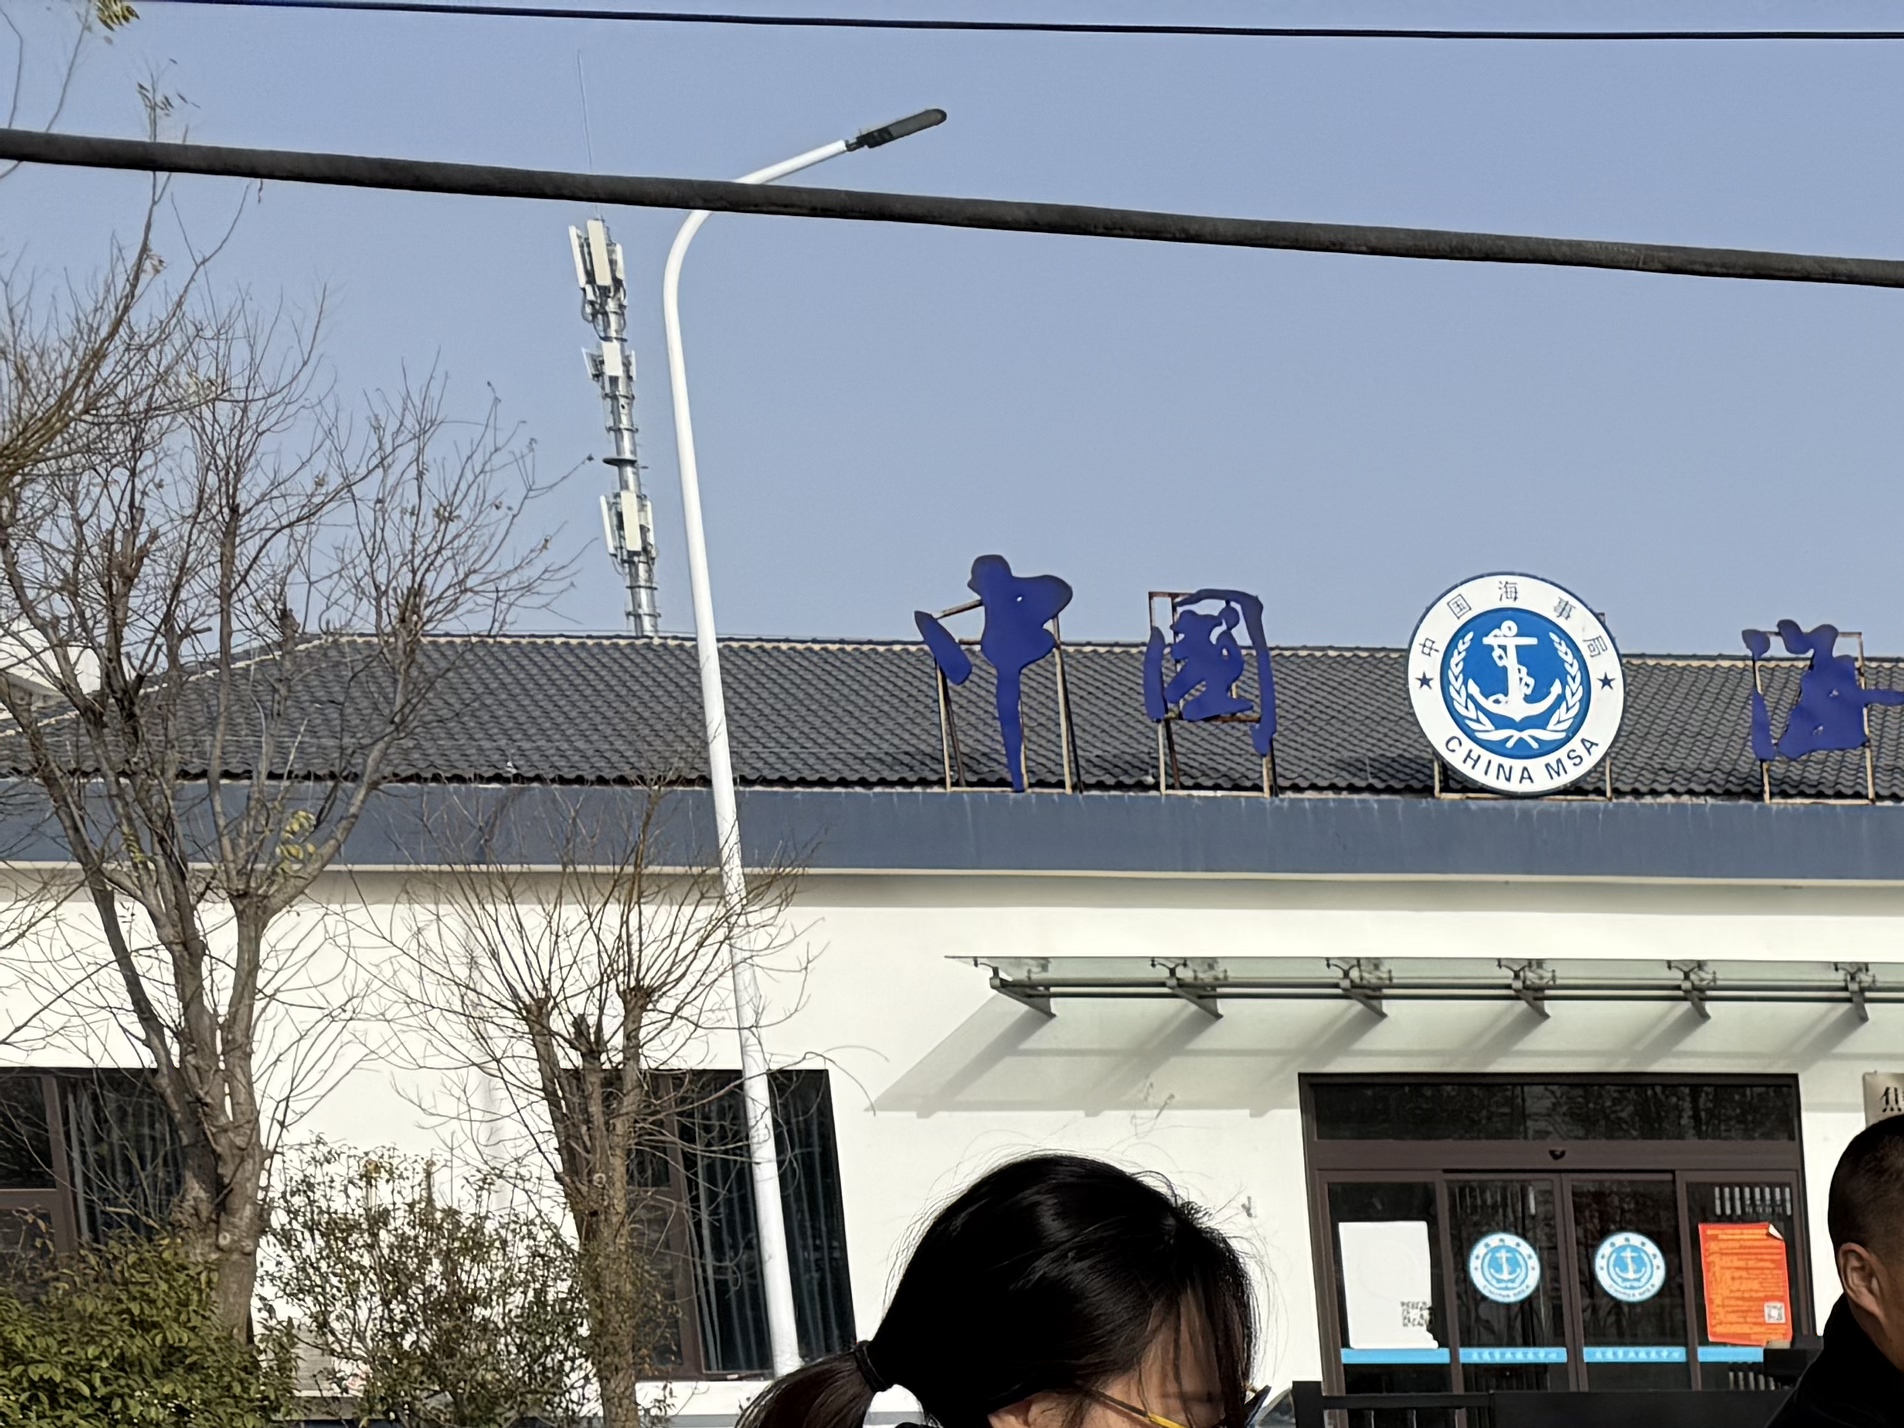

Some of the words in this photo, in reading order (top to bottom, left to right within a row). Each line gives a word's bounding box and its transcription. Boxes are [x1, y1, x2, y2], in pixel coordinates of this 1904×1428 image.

[1418, 580, 1608, 658] 中国海事局
[1445, 735, 1535, 785] CHINA
[1544, 736, 1600, 781] MSA
